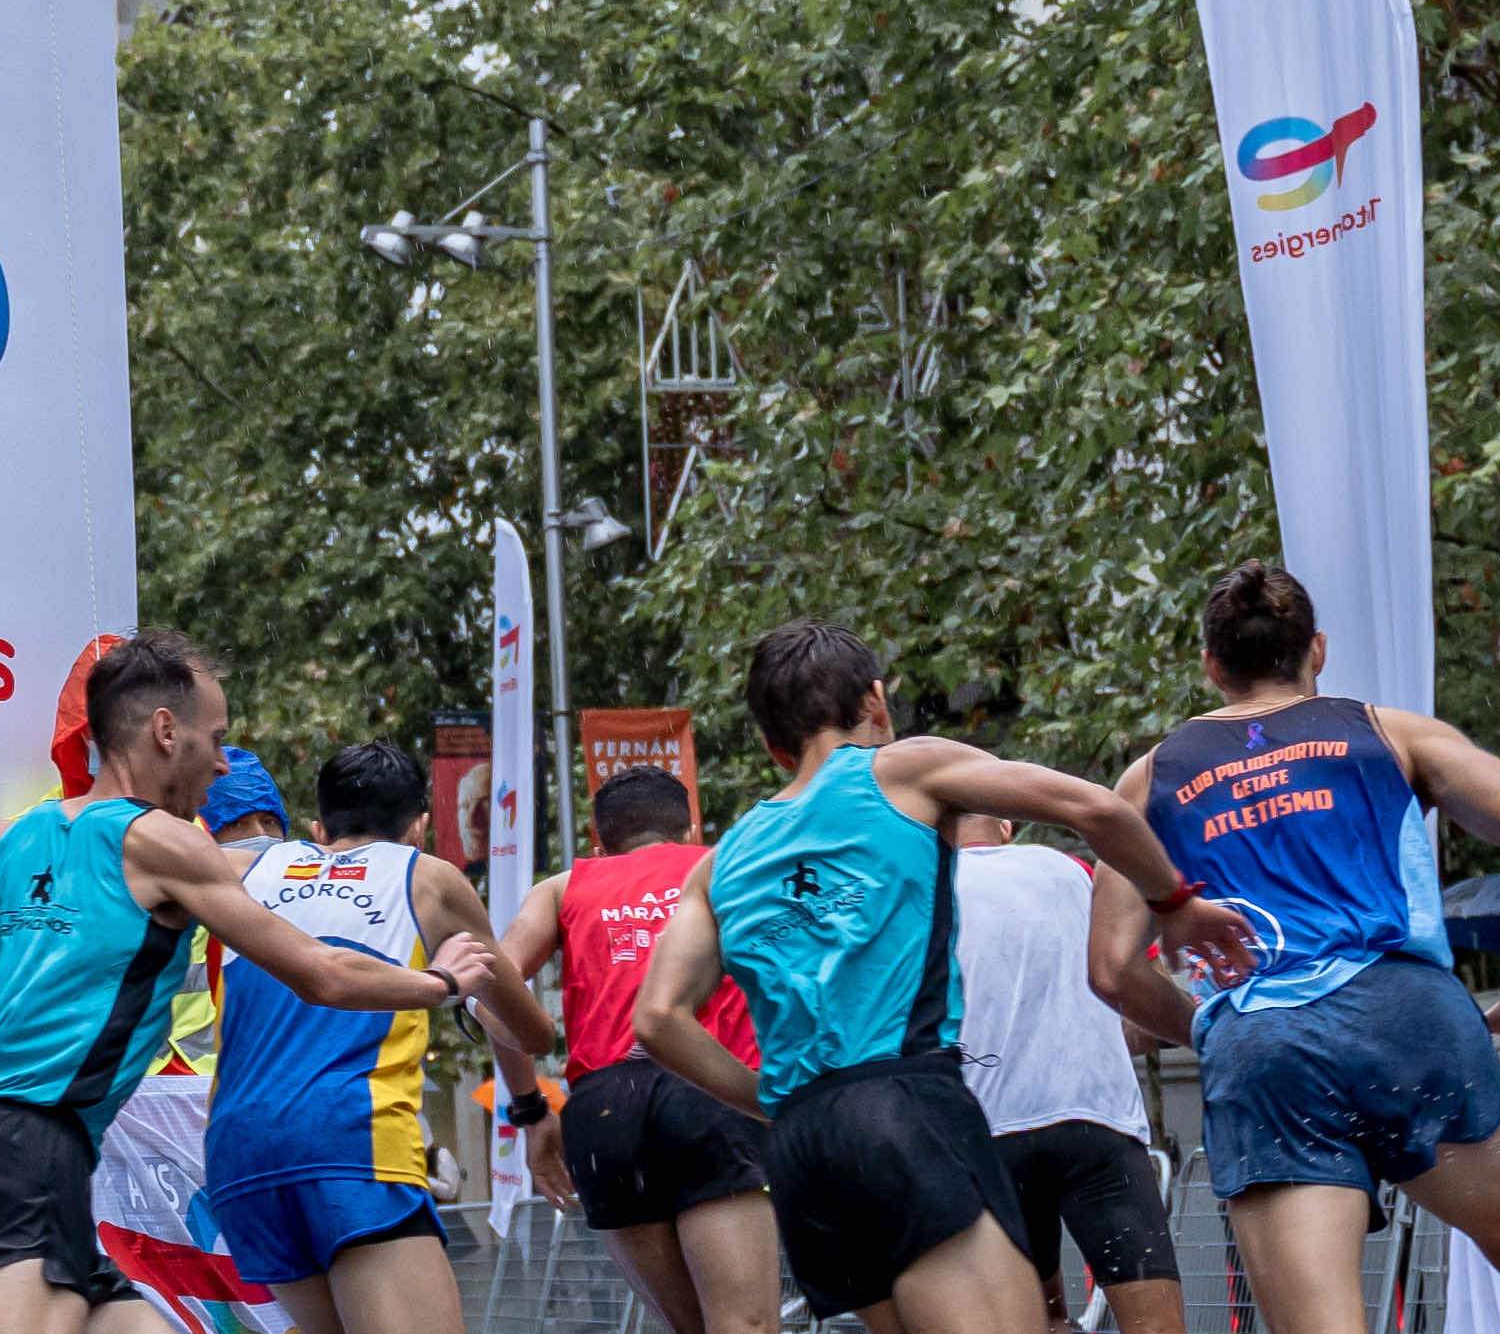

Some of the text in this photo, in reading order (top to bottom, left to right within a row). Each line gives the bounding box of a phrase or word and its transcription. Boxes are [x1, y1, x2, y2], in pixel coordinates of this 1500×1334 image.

[1176, 741, 1348, 805] CLUB POLIDEPORTIVO
[1232, 769, 1289, 800] GETAFE
[1204, 789, 1335, 843] ATLETISMO
[263, 883, 386, 925] LCORCÓN
[601, 903, 681, 922] MARAT
